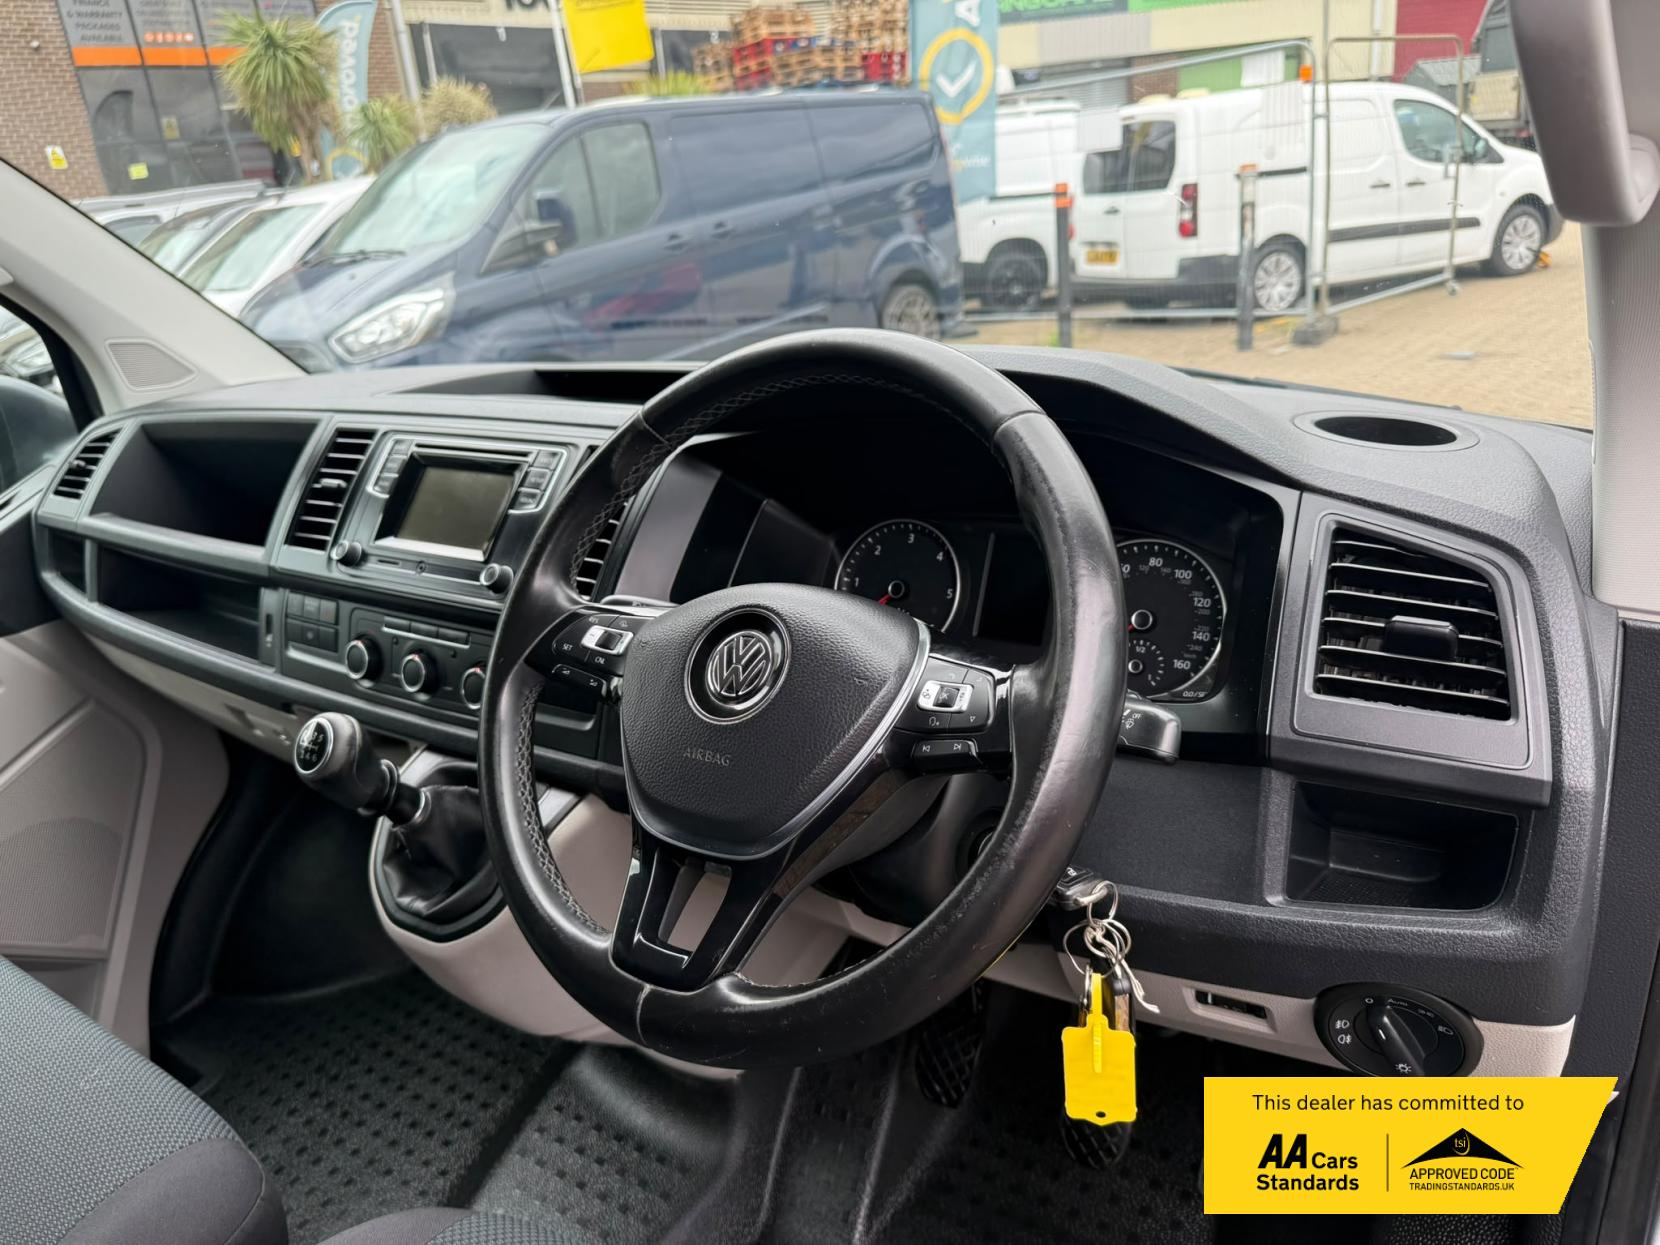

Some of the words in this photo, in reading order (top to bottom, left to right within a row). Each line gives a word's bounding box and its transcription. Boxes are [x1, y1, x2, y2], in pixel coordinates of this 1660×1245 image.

[907, 533, 915, 544] 3
[874, 545, 882, 556] 2
[936, 551, 944, 562] 4
[1149, 557, 1164, 567] 80
[1174, 569, 1192, 580] 100
[854, 577, 860, 588] 1
[946, 588, 954, 600] 5
[1193, 597, 1212, 608] 120
[1191, 630, 1211, 642] 140
[562, 643, 573, 652] SET
[1172, 659, 1191, 671] 160
[683, 748, 731, 766] AIRBAG
